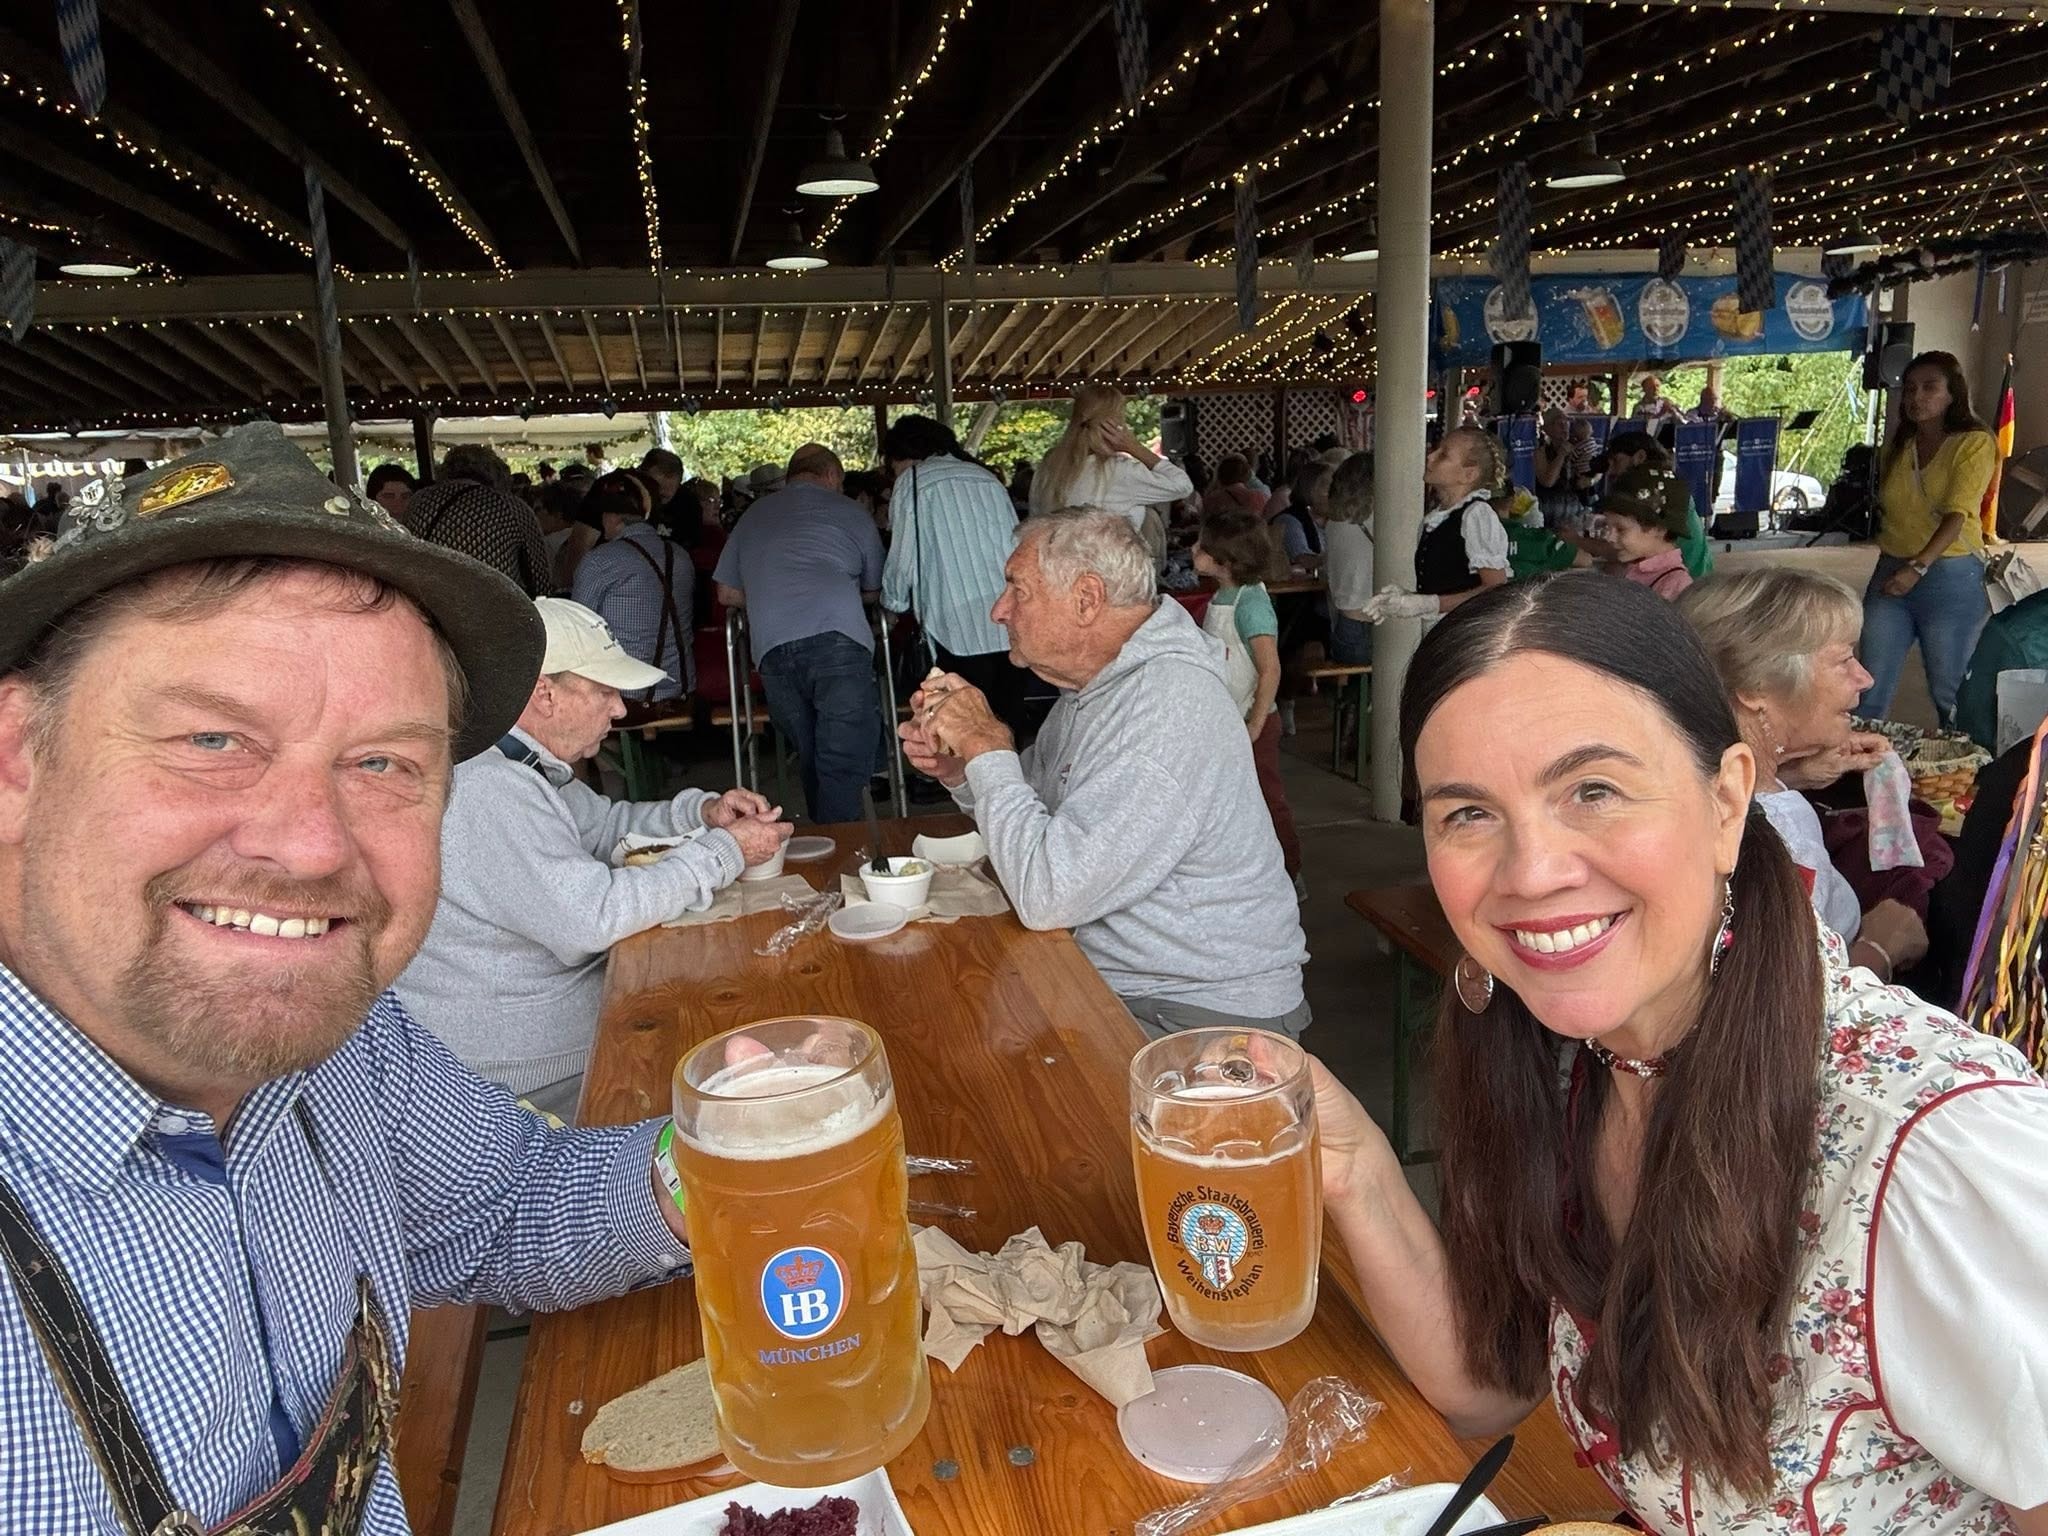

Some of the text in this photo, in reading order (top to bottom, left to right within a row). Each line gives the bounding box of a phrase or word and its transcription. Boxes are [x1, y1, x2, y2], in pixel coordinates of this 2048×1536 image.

[1167, 1185, 1268, 1250] Bayerische Staatsbrauerei
[1177, 1259, 1264, 1302] Weihenstephan
[780, 1289, 829, 1327] HB
[759, 1333, 861, 1365] MÜNCHEN
